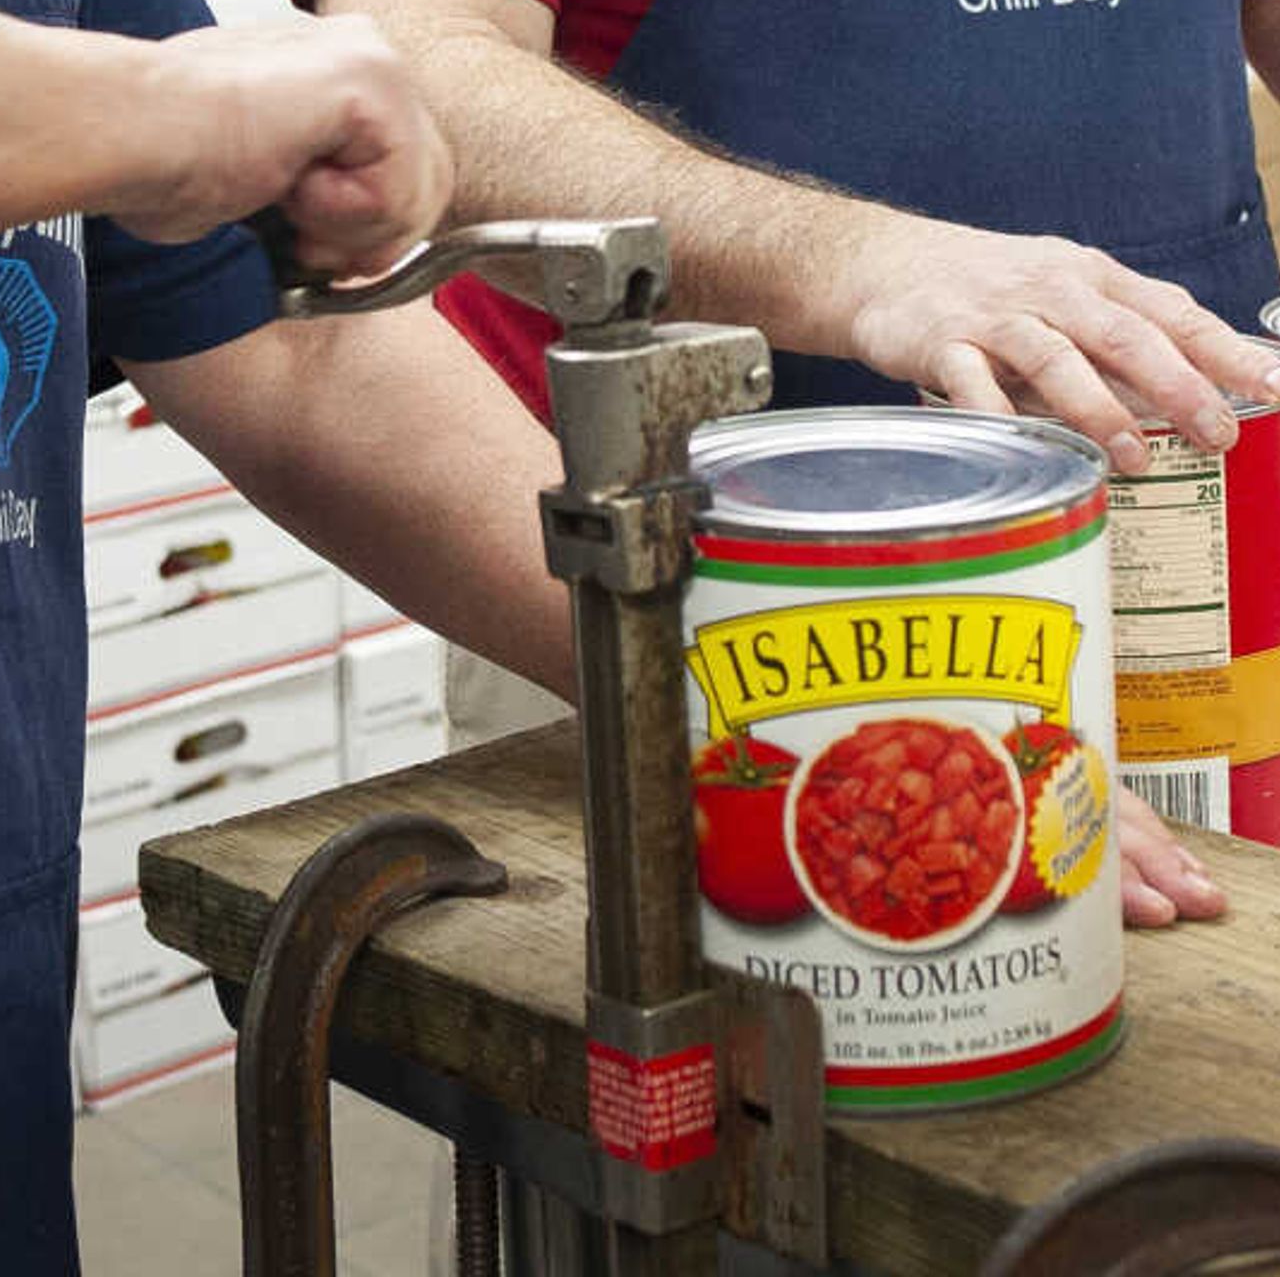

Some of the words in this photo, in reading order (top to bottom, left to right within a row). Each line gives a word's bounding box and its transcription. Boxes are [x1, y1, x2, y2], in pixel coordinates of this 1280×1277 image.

[722, 614, 1046, 704] ISABELLA
[870, 936, 1063, 1000] TOMATOES
[865, 1006, 937, 1026] Tomato
[942, 1002, 988, 1023] Juice
